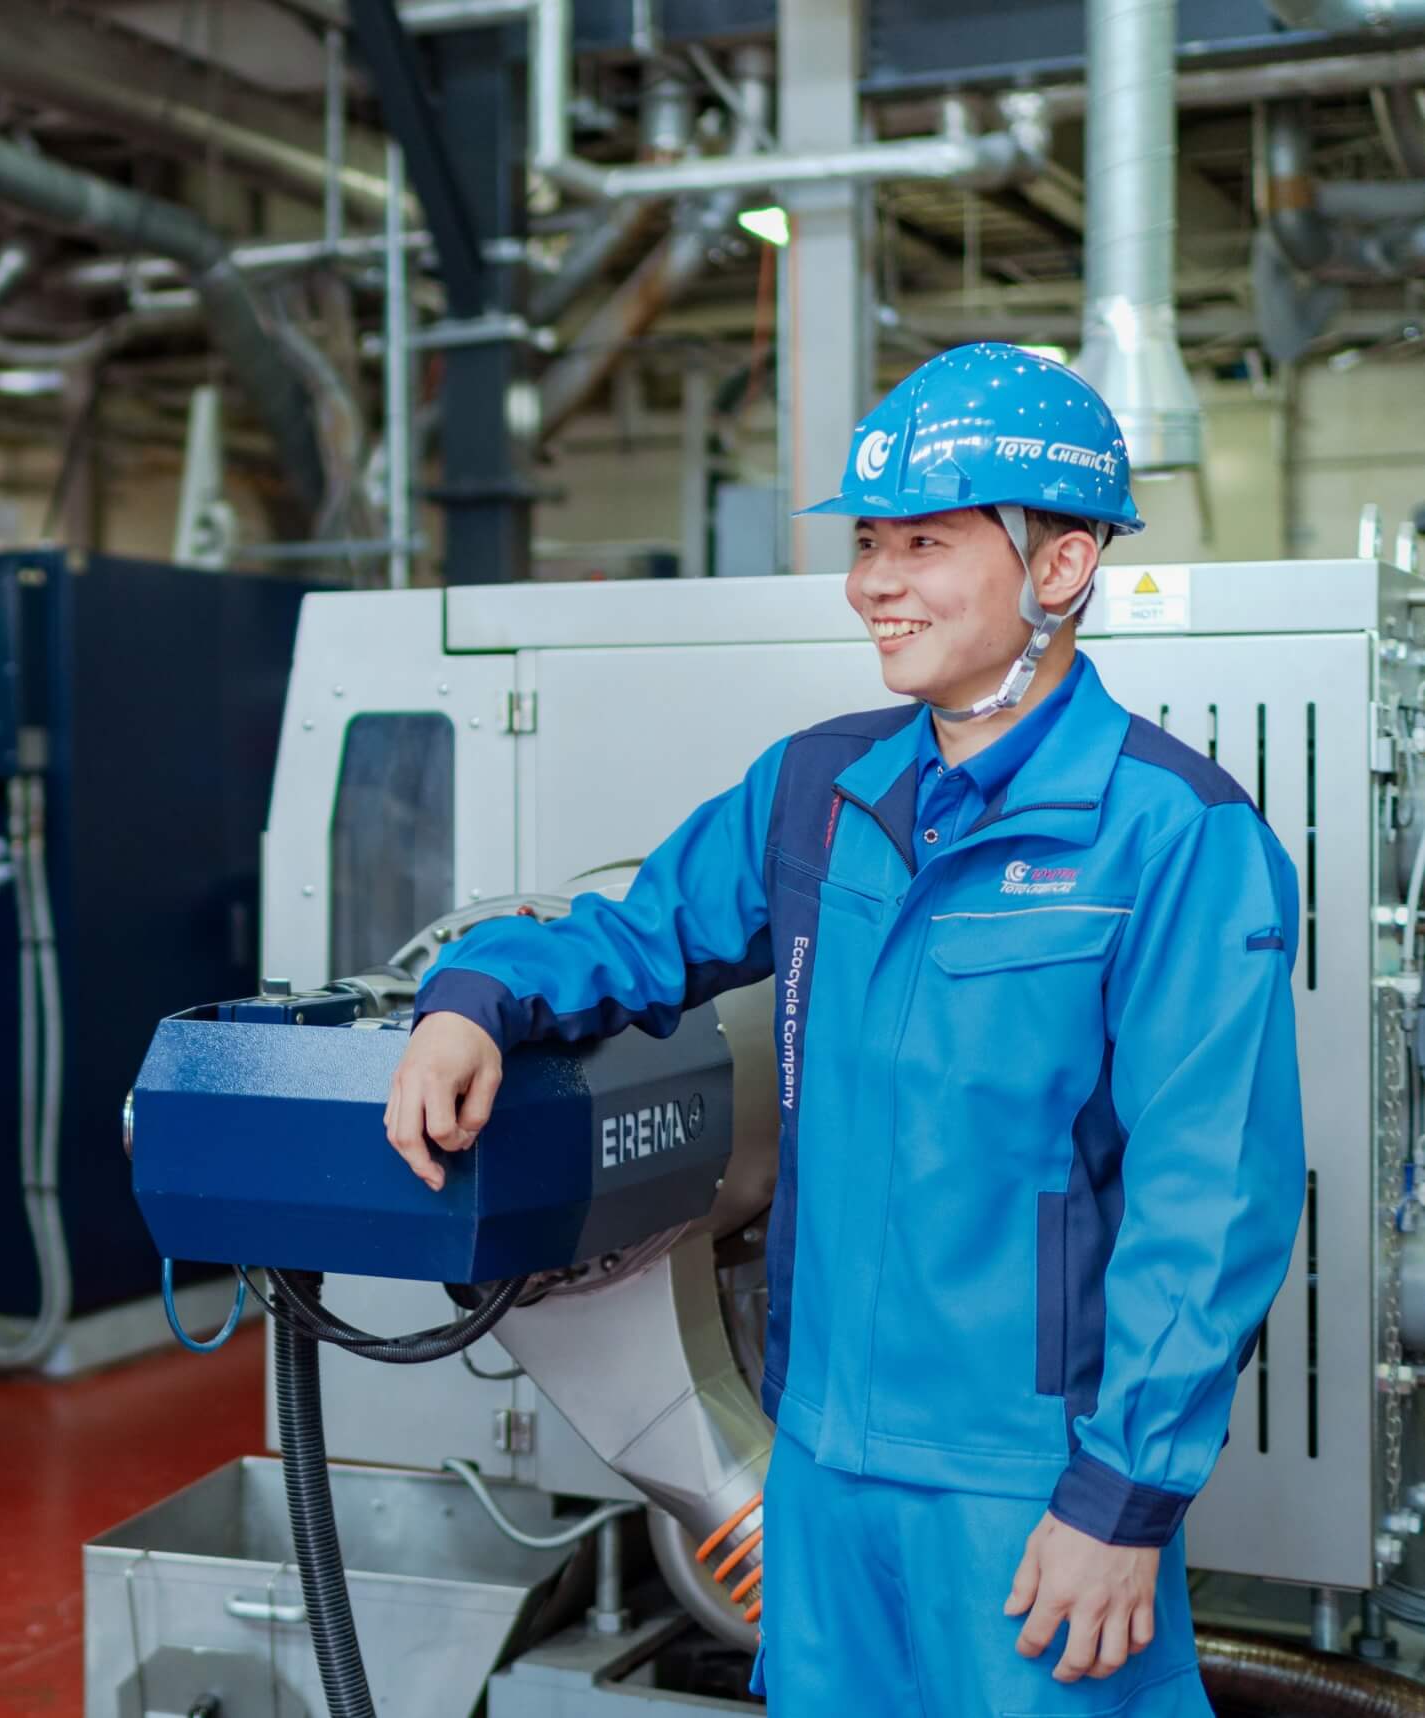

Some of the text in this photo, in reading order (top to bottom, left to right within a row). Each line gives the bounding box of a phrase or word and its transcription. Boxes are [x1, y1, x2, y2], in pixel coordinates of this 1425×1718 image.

[995, 436, 1118, 476] TOYO CHEMICAL
[782, 936, 809, 1109] Ecocycle Company
[602, 1101, 686, 1168] EREMA
